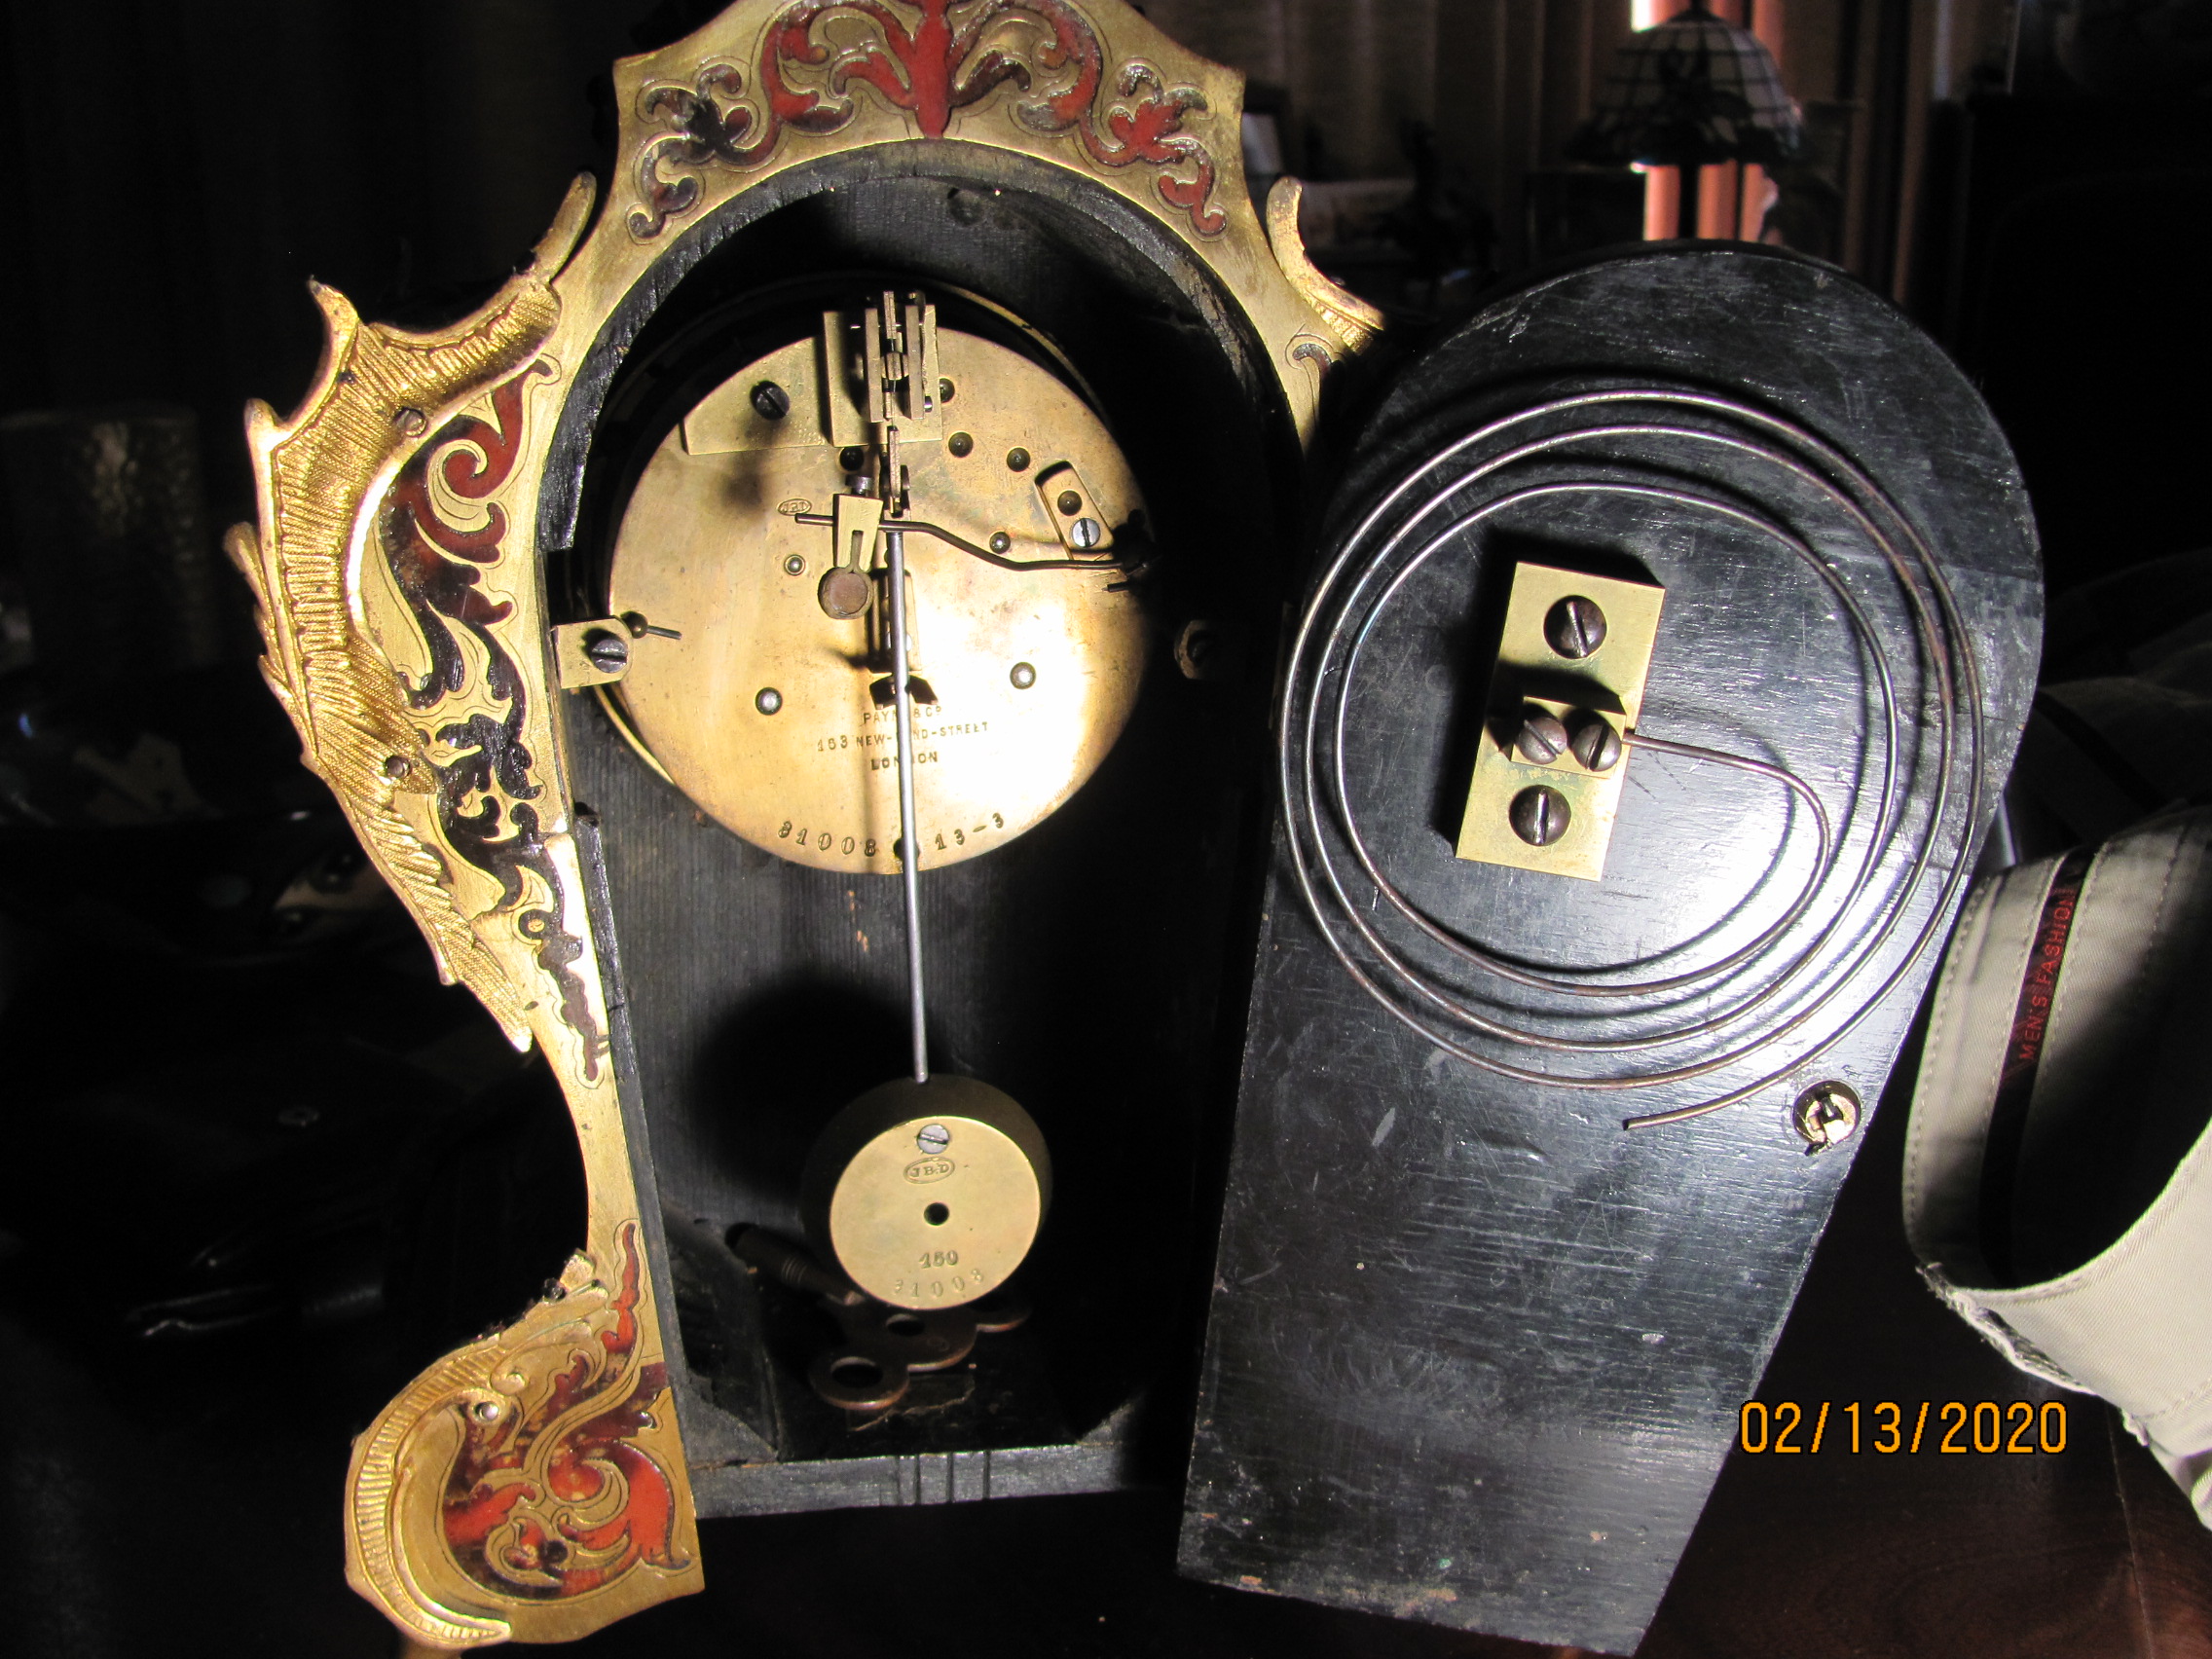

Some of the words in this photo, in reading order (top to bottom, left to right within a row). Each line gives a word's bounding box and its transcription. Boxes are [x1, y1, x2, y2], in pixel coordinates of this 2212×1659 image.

[863, 709, 911, 724] PAYN
[856, 721, 987, 748] NEW-ND-STREET
[870, 751, 939, 770] LONON
[2018, 995, 2049, 1061] MEN'S
[2035, 893, 2076, 984] FASHION
